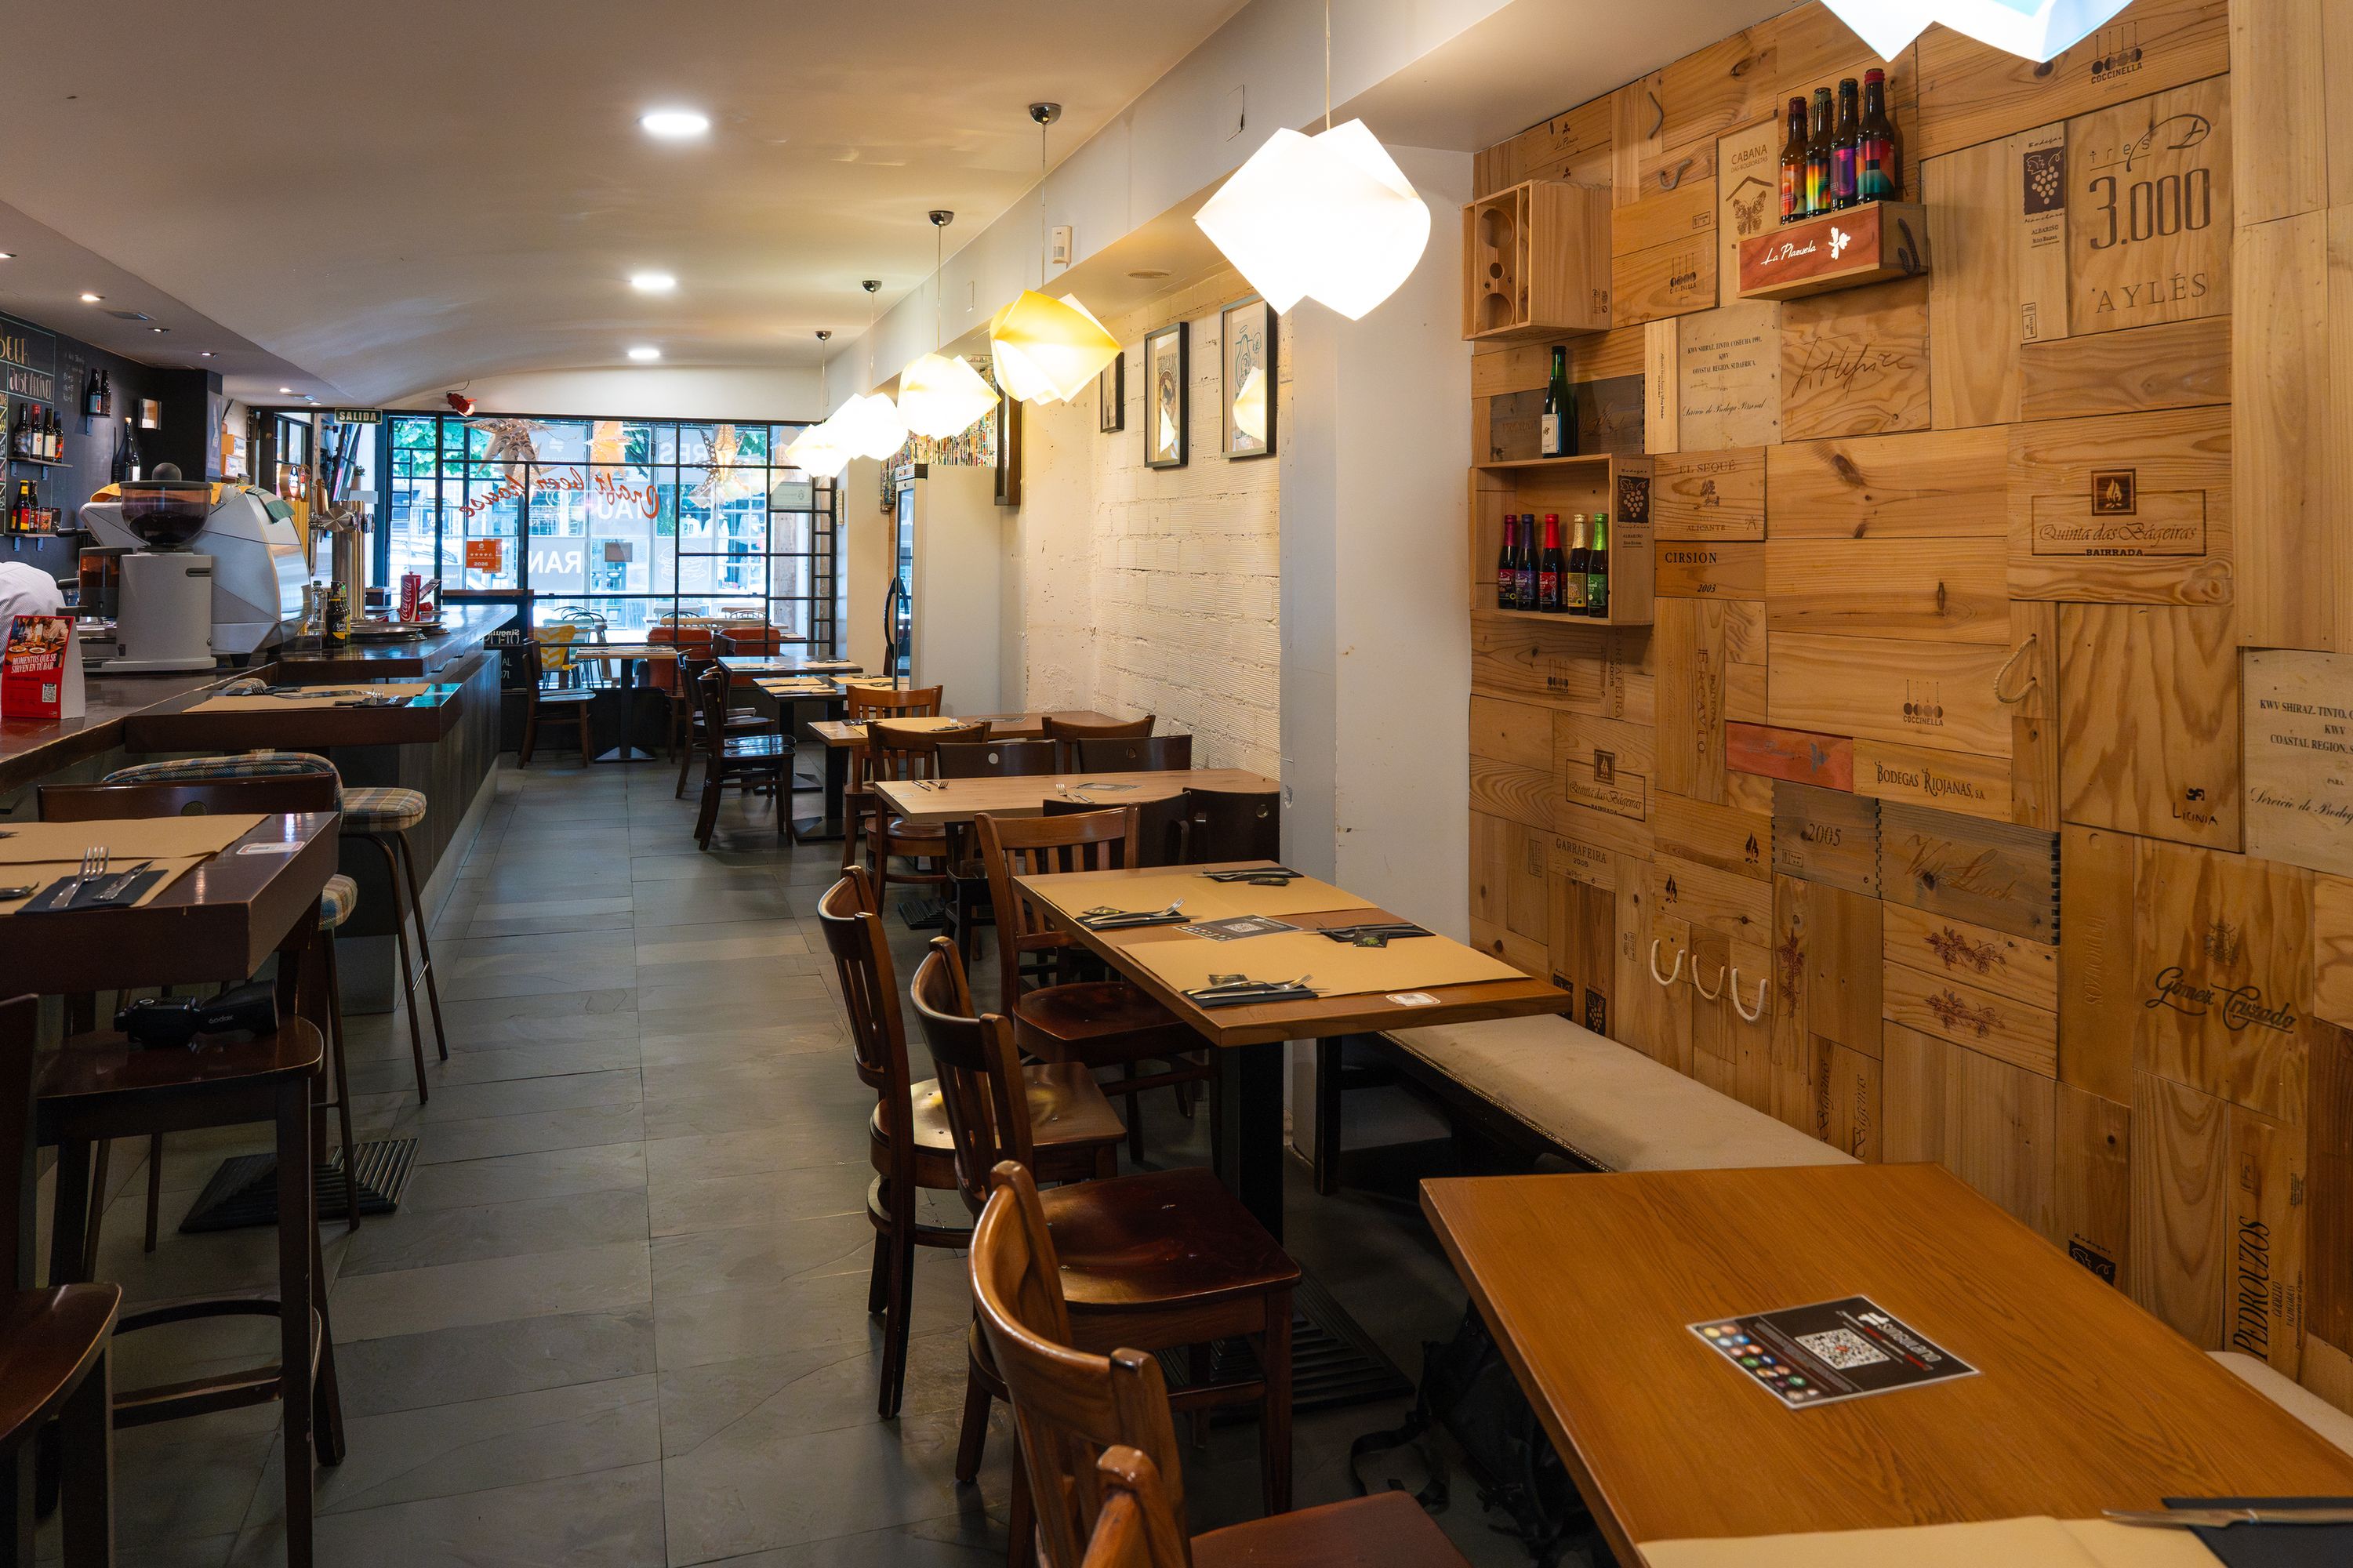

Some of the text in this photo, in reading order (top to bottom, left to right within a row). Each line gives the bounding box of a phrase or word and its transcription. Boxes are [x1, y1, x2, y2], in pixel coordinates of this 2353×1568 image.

[2091, 62, 2143, 84] COCCINELLA
[1731, 144, 1767, 165] CABANA
[2089, 138, 2150, 164] tres
[2089, 169, 2211, 250] 3.000
[1760, 240, 1817, 265] La Plazuela
[2095, 273, 2207, 314] AYLÉS
[1730, 338, 1752, 347] COSECHA
[1692, 366, 1712, 375] COASTAL
[340, 411, 376, 422] SALIDA
[1705, 405, 1712, 415] de
[1679, 459, 1737, 474] EL SEQUÉ
[1687, 524, 1726, 532] ALICANTE
[2039, 521, 2197, 547] Quinta das Bágeiras
[1665, 552, 1717, 564] CIRSION
[1697, 583, 1716, 593] 2003
[11, 662, 54, 673] SIRVEN EN TU BAR
[13, 655, 40, 665] MOMENTOS
[50, 653, 57, 662] SE
[2260, 699, 2280, 710] KWV
[1903, 715, 1944, 727] COCCINELLA
[2324, 724, 2346, 735] KWV
[2271, 735, 2309, 749] COASTAL
[1875, 761, 1919, 787] BODEGAS
[1569, 781, 1643, 810] Quinta das Bágeiras
[2250, 787, 2294, 809] Servicio
[2298, 799, 2311, 811] de
[1590, 804, 1618, 815] BAIRRADA
[1808, 823, 1842, 846] 2005
[1556, 838, 1607, 864] GARRAFEIRA
[2211, 985, 2297, 1033] Cruzado
[2233, 1215, 2270, 1362] PEDROUZOS
[2271, 1281, 2282, 1318] GODELLO
[2286, 1285, 2294, 1327] VALDEORRAS
